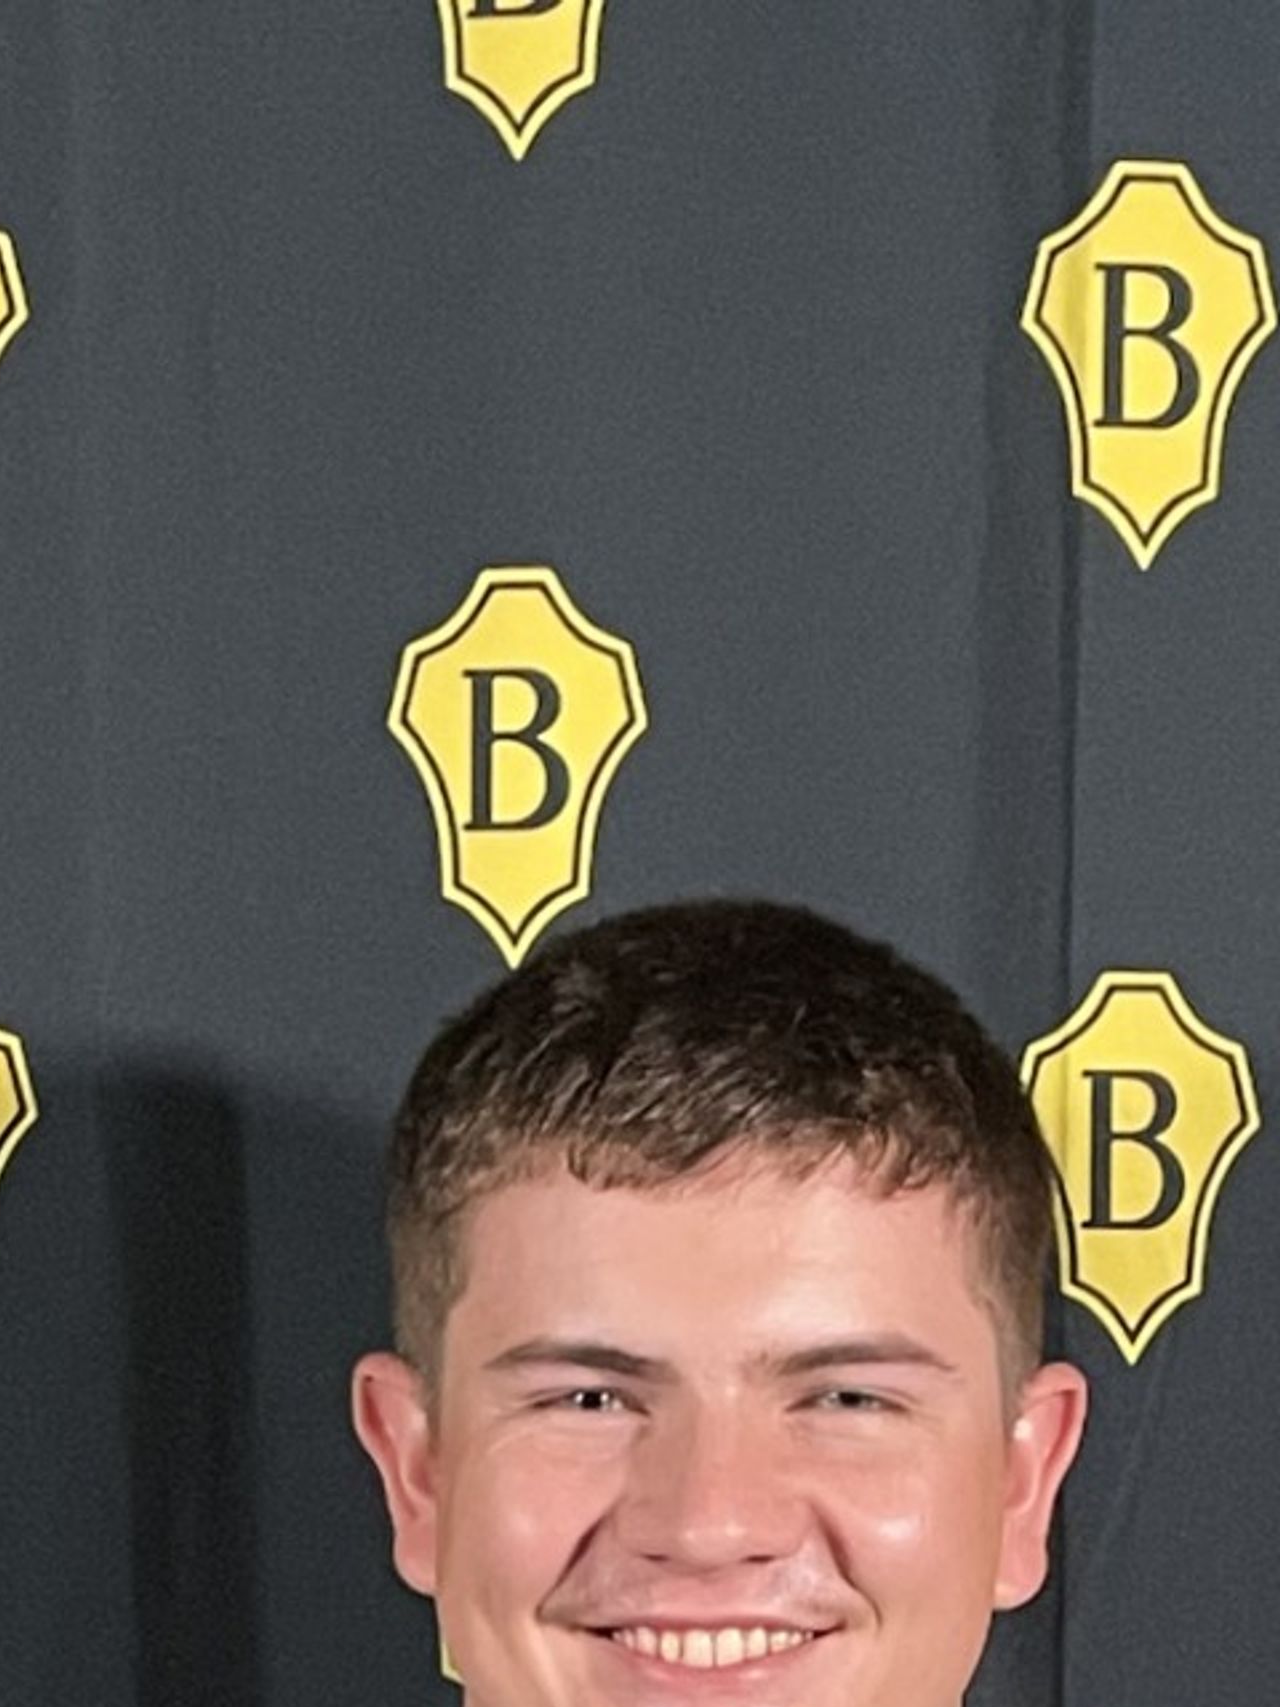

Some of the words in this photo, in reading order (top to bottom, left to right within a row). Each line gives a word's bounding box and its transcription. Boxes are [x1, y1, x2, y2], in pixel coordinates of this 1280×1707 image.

[1095, 264, 1198, 428] B
[464, 670, 568, 830] B
[1082, 1071, 1184, 1229] B
